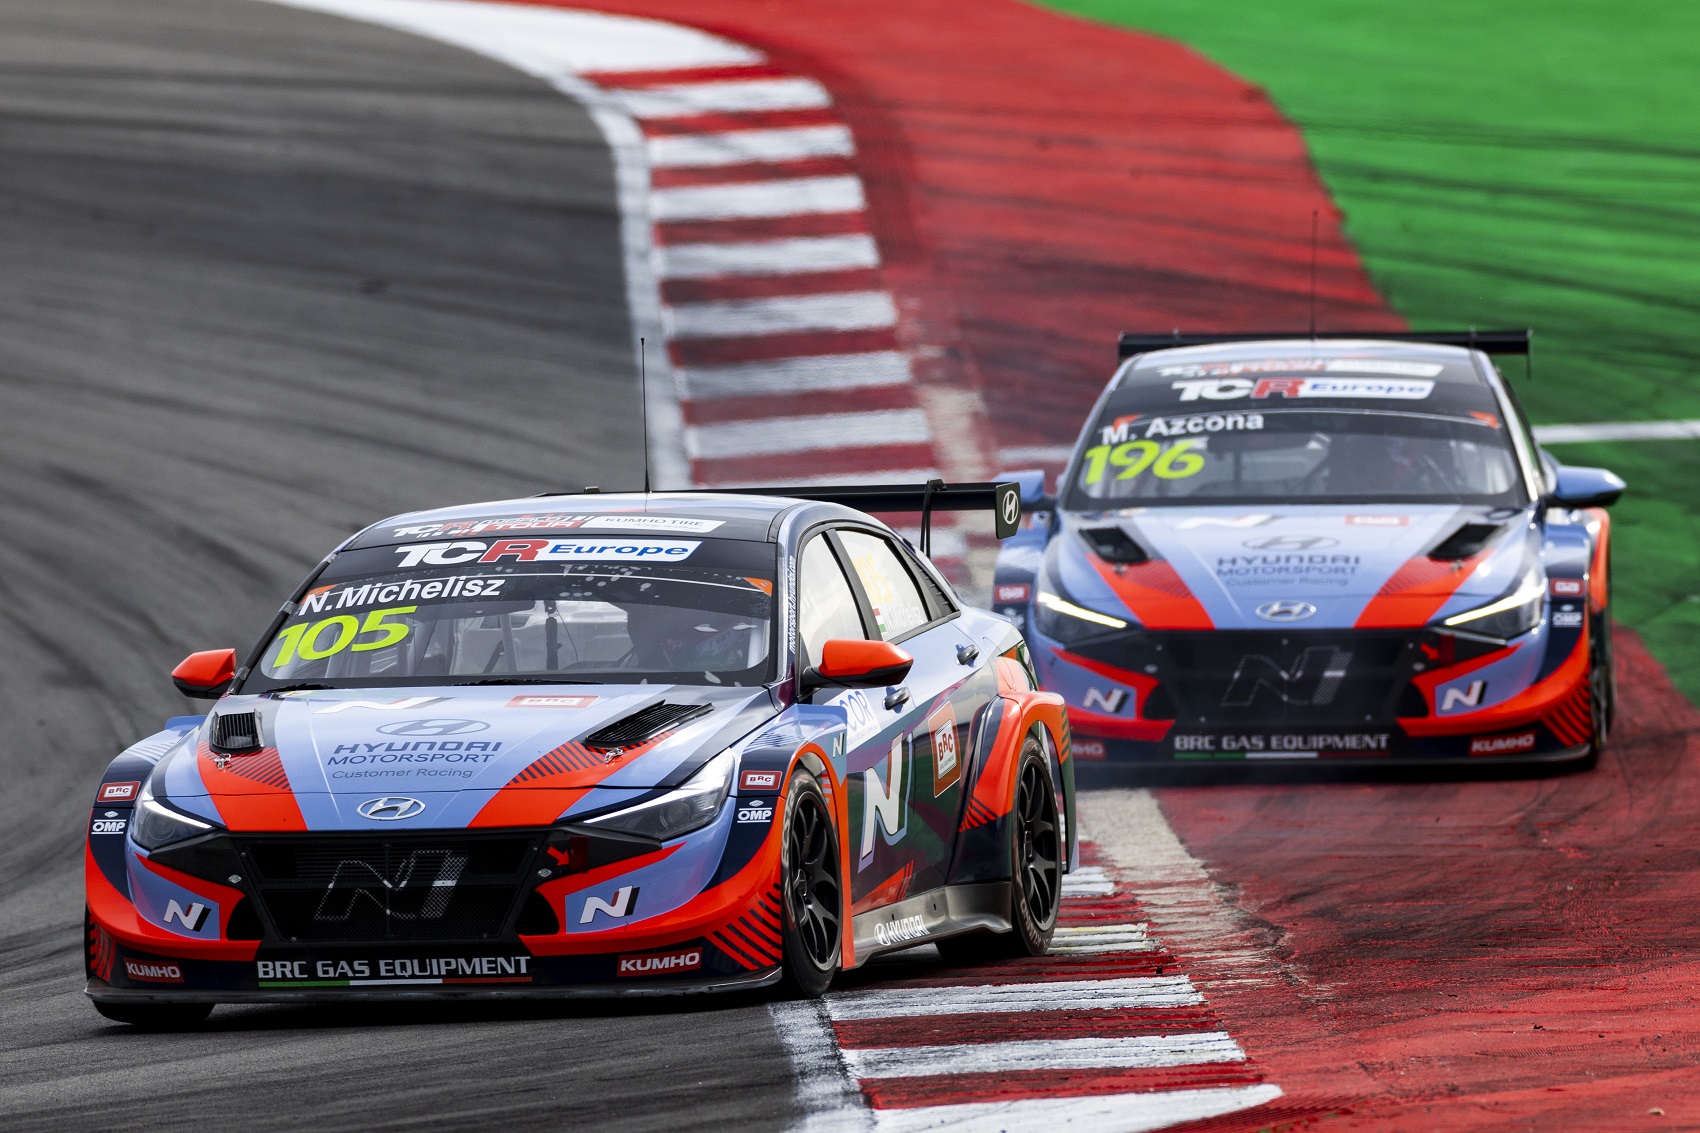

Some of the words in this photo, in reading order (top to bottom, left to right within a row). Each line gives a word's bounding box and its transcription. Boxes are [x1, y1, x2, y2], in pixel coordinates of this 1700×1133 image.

[1171, 377, 1304, 401] TCR
[1311, 383, 1425, 394] Europe
[1102, 424, 1133, 446] M.
[1146, 413, 1264, 438] Azcona
[1084, 438, 1205, 486] 196
[395, 539, 549, 567] TCR
[550, 543, 689, 556] Europe
[1217, 555, 1361, 566] HYUNDAI
[1216, 565, 1359, 577] MOTORSPORT
[272, 605, 418, 668] 105
[333, 741, 503, 754] HYUNDAI
[938, 732, 954, 762] BRC
[1174, 735, 1216, 750] BRC
[1221, 735, 1264, 750] GAS
[1270, 734, 1390, 750] EQUIPMENT
[1472, 734, 1535, 752] KUMHO
[327, 753, 495, 765] MOTORSPORT
[332, 769, 417, 779] Customer
[416, 768, 473, 779] Racing
[737, 810, 772, 821] OMP
[92, 821, 126, 832] OMP
[886, 914, 930, 943] HYUNDAI
[126, 961, 181, 978] KUMHO
[257, 960, 308, 978] BRC
[316, 960, 371, 978] GAS
[379, 956, 531, 977] EQUIPMENT
[620, 952, 701, 972] KUMHO
